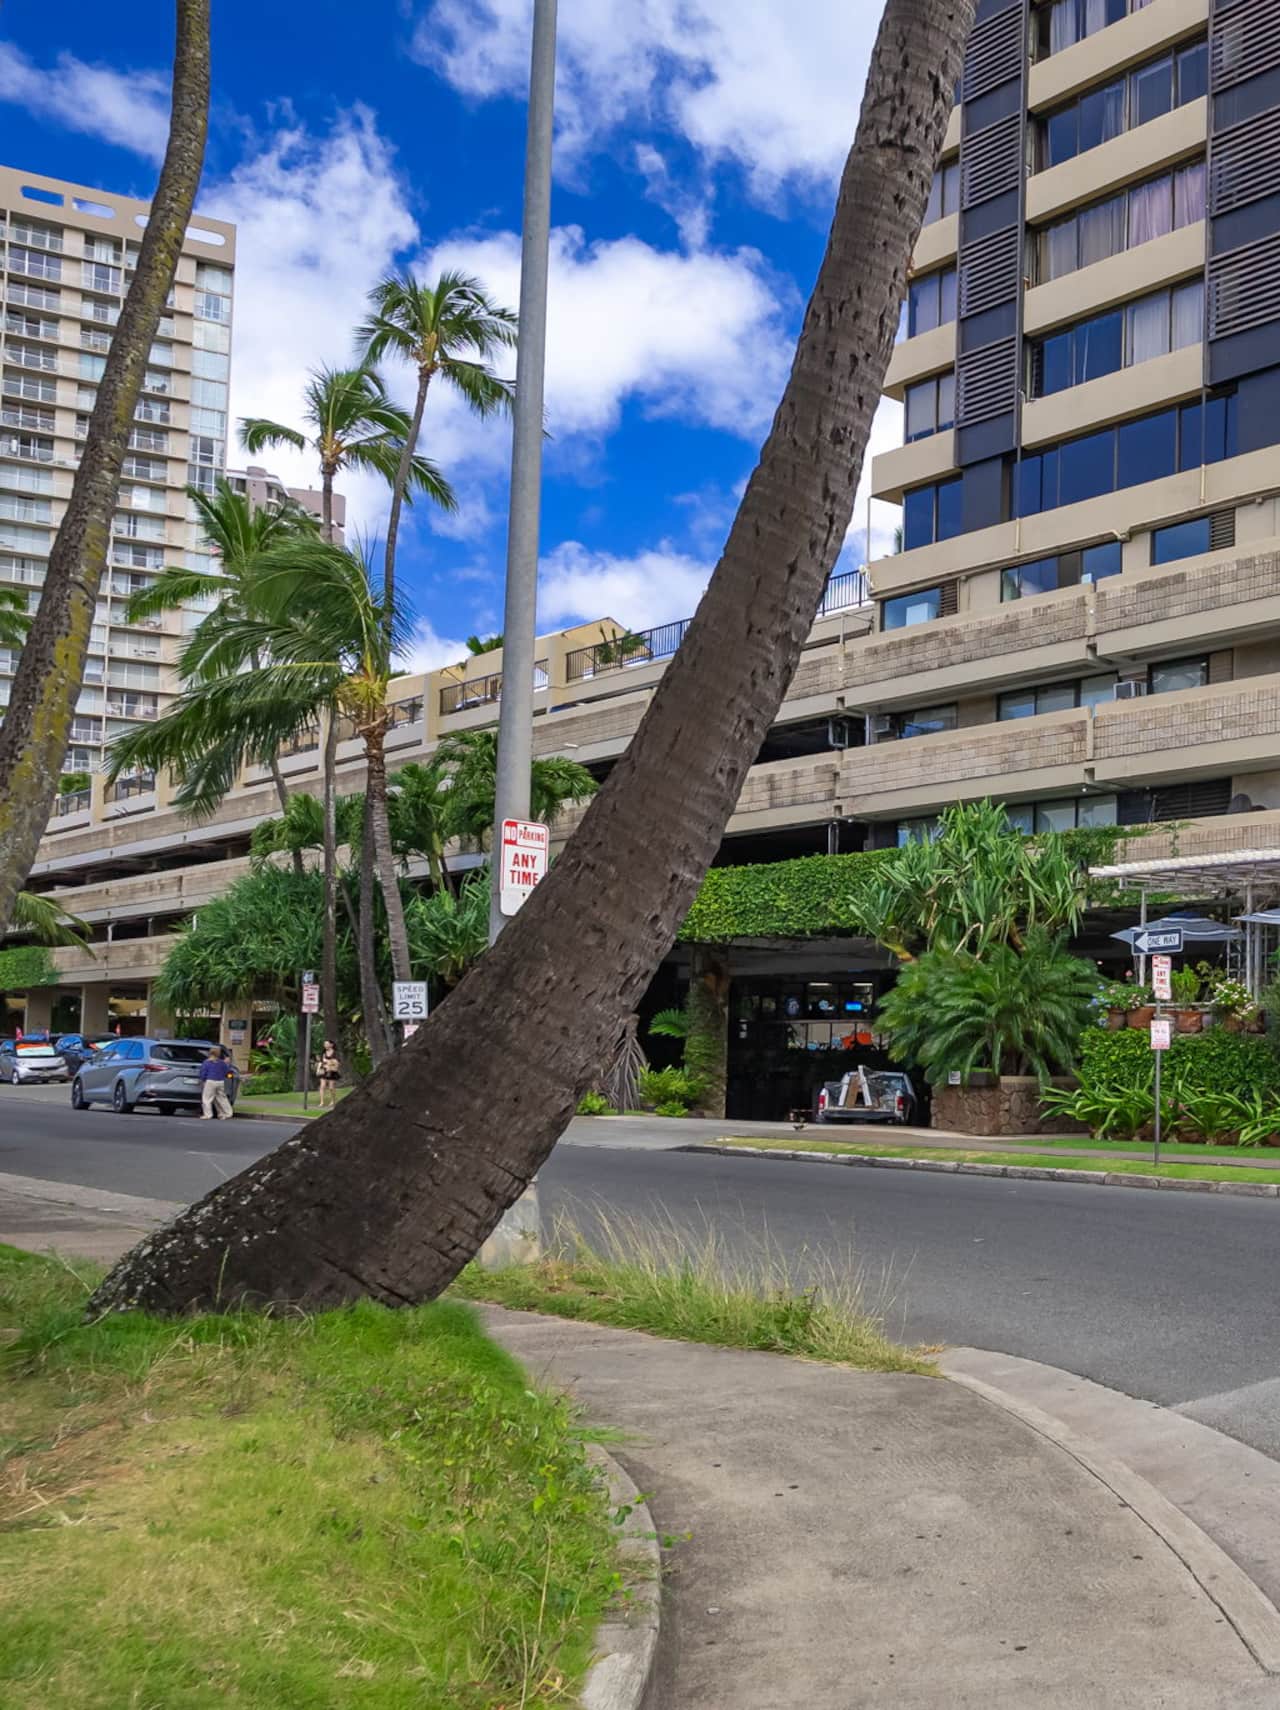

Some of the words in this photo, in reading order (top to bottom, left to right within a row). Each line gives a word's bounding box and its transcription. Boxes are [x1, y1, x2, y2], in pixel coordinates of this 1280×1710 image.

[503, 825, 517, 842] NO
[519, 829, 545, 843] PARKING
[512, 853, 537, 868] ANY
[510, 870, 539, 887] TIME
[1147, 936, 1161, 946] ONE
[1163, 935, 1177, 945] WAY
[397, 985, 425, 993] SPEED
[398, 1001, 424, 1015] 25
